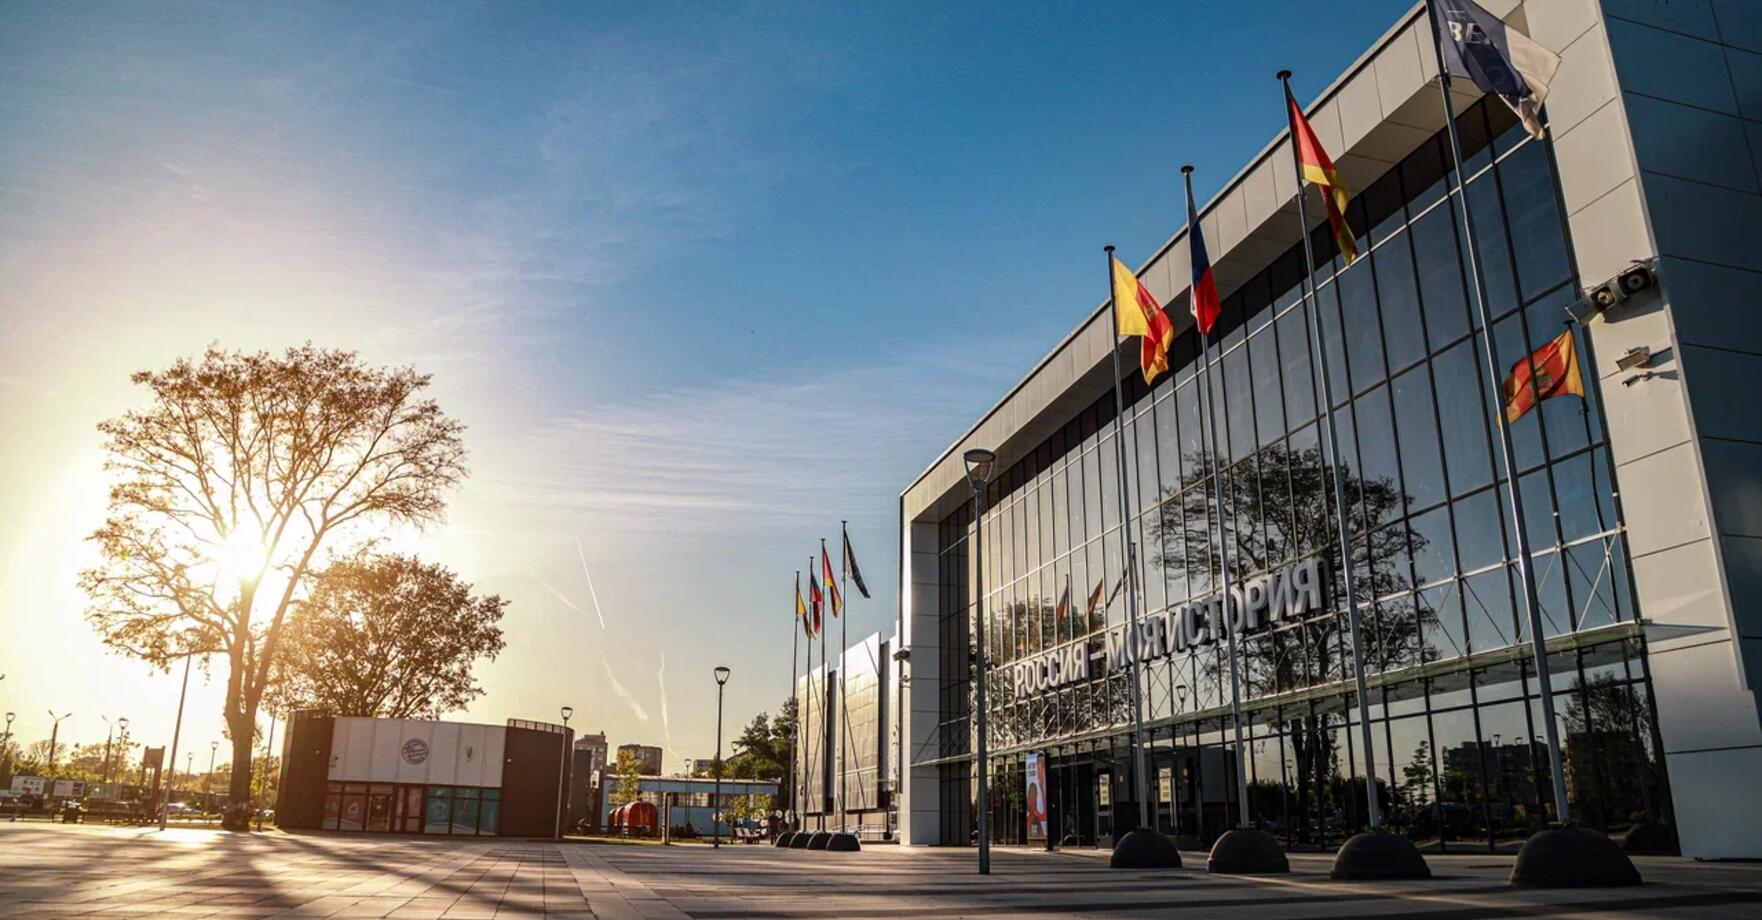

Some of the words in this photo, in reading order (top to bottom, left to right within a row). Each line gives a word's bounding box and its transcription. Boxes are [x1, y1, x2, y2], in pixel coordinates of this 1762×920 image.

[1014, 641, 1086, 698] РОССИЯ
[1105, 616, 1158, 670] МОЯ
[1165, 558, 1325, 653] ИСТОРИЯ
